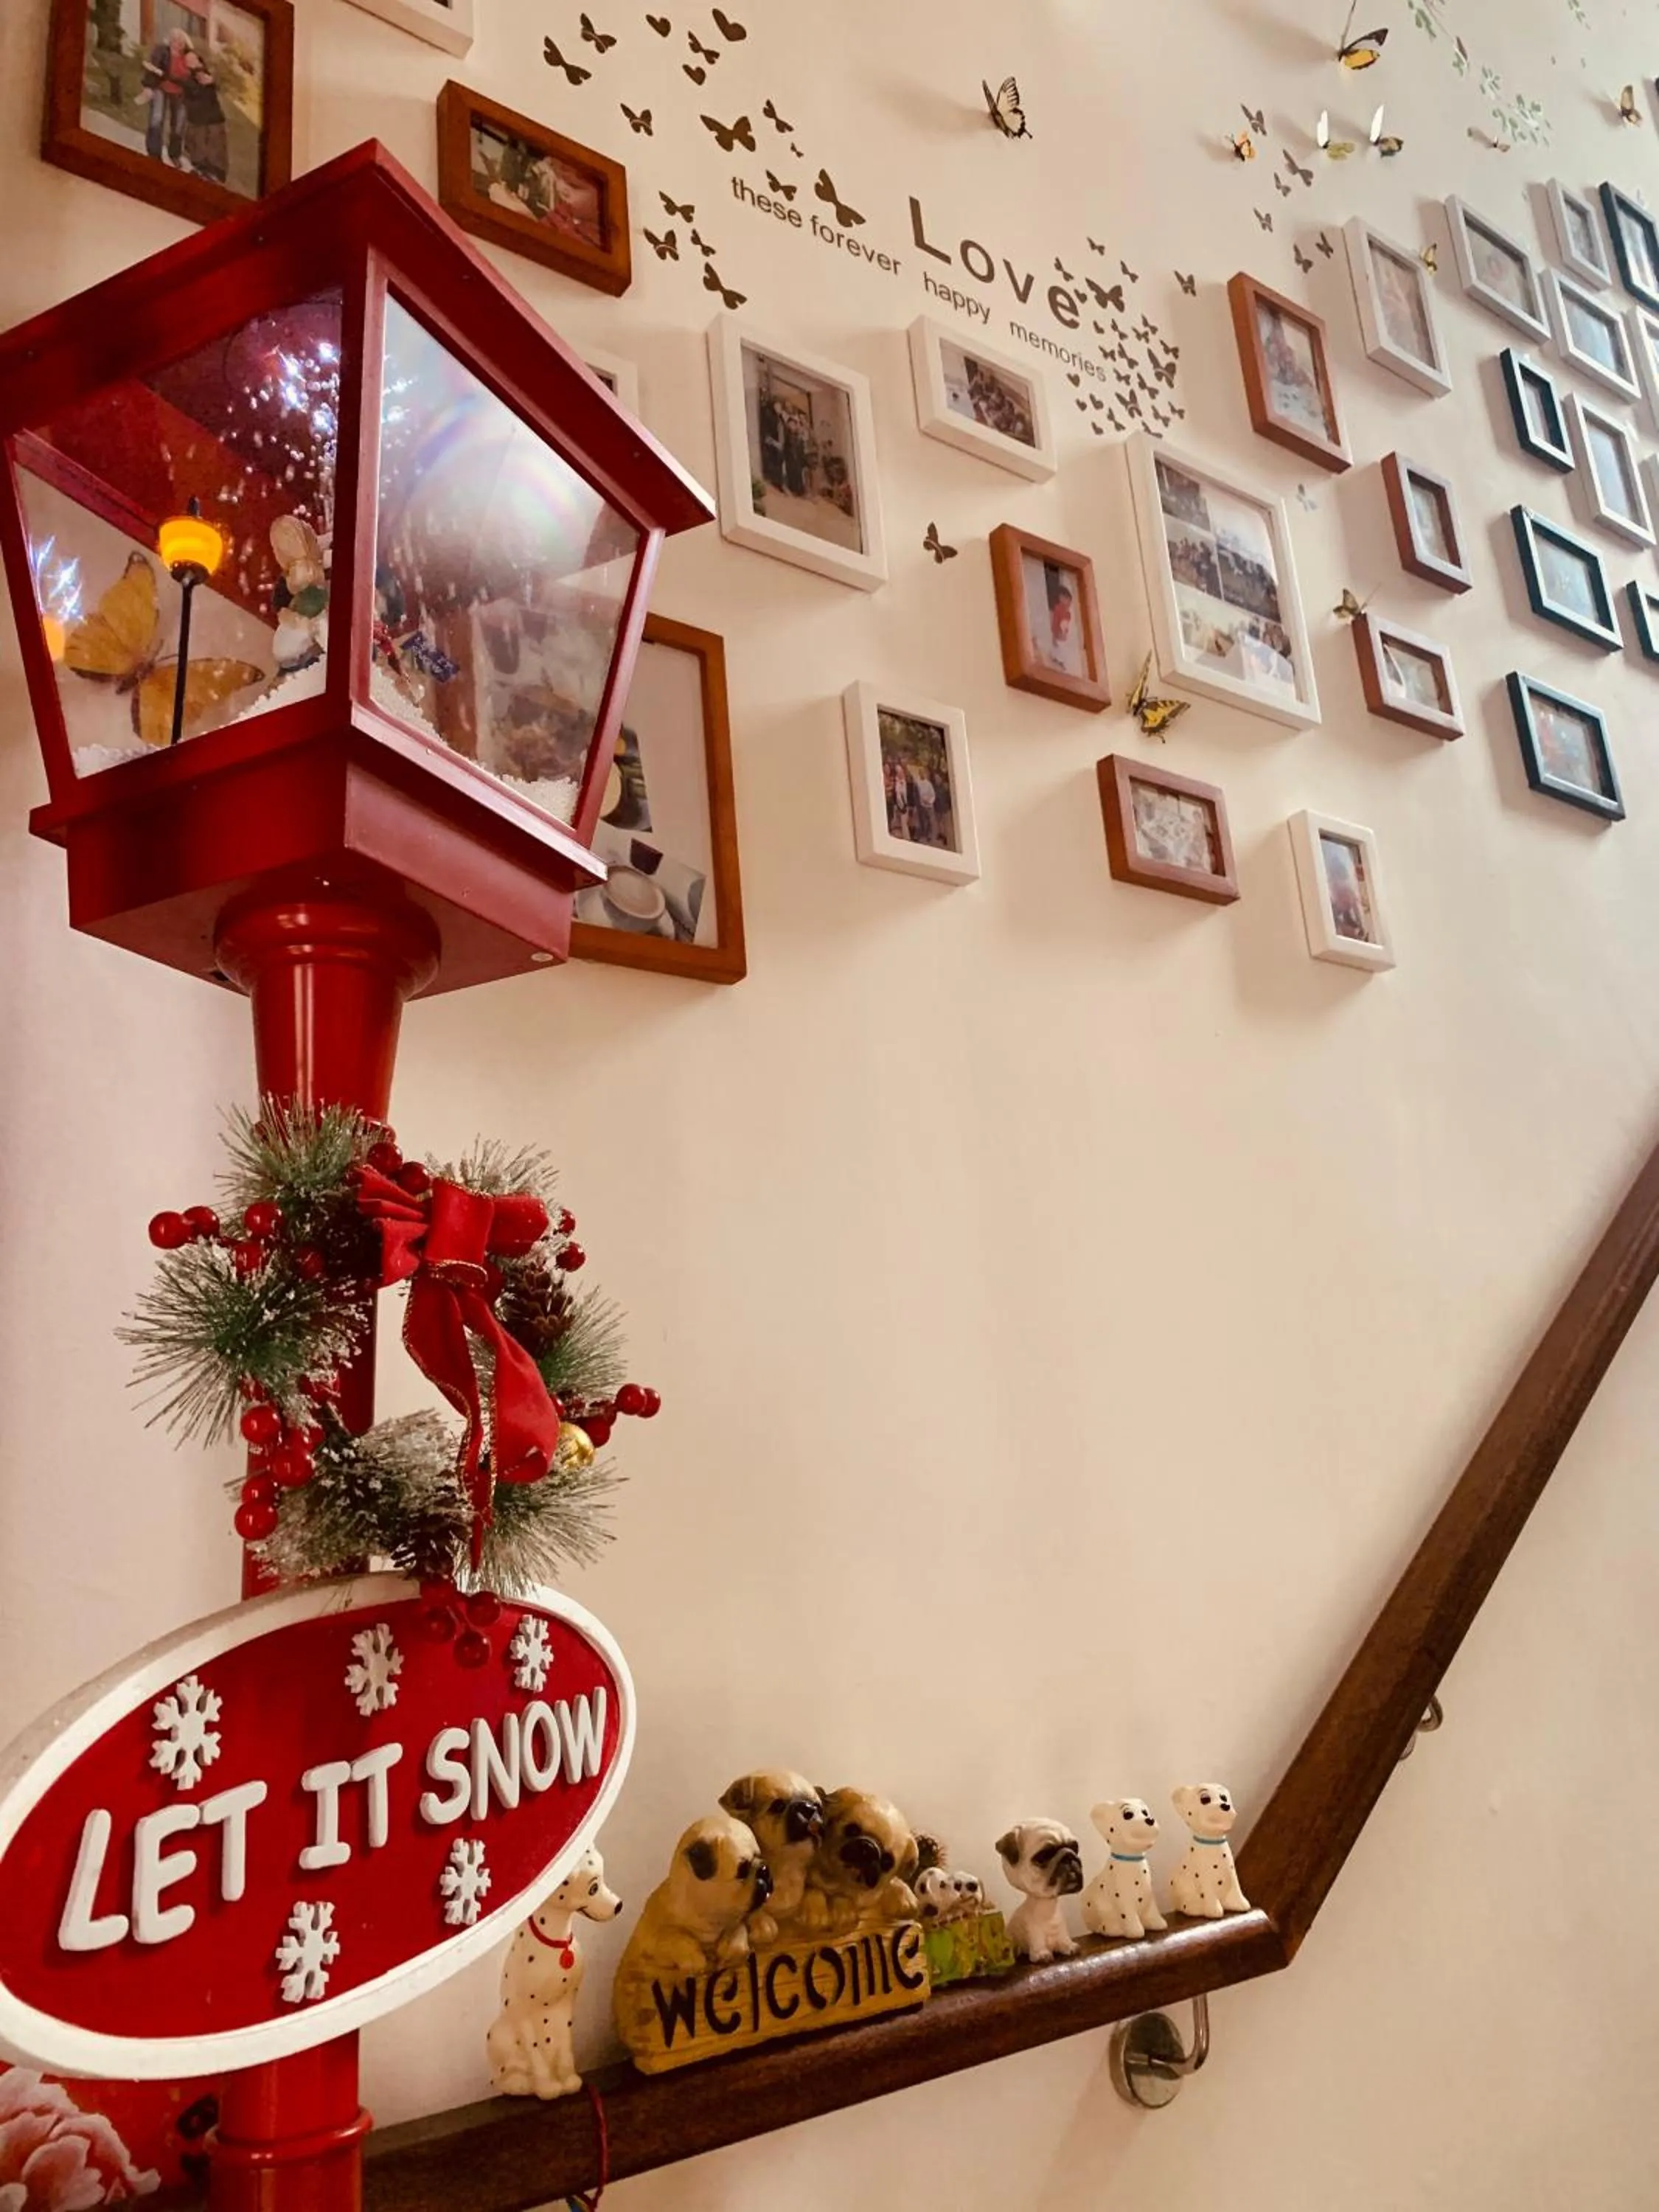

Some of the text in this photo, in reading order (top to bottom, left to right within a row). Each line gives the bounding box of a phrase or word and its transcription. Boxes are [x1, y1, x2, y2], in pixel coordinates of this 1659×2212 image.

[731, 176, 901, 276] these forever
[908, 196, 1081, 329] Love
[922, 271, 1106, 382] happy memories
[58, 1686, 607, 1952] LET IT SNOW
[651, 1925, 928, 2049] welcome
